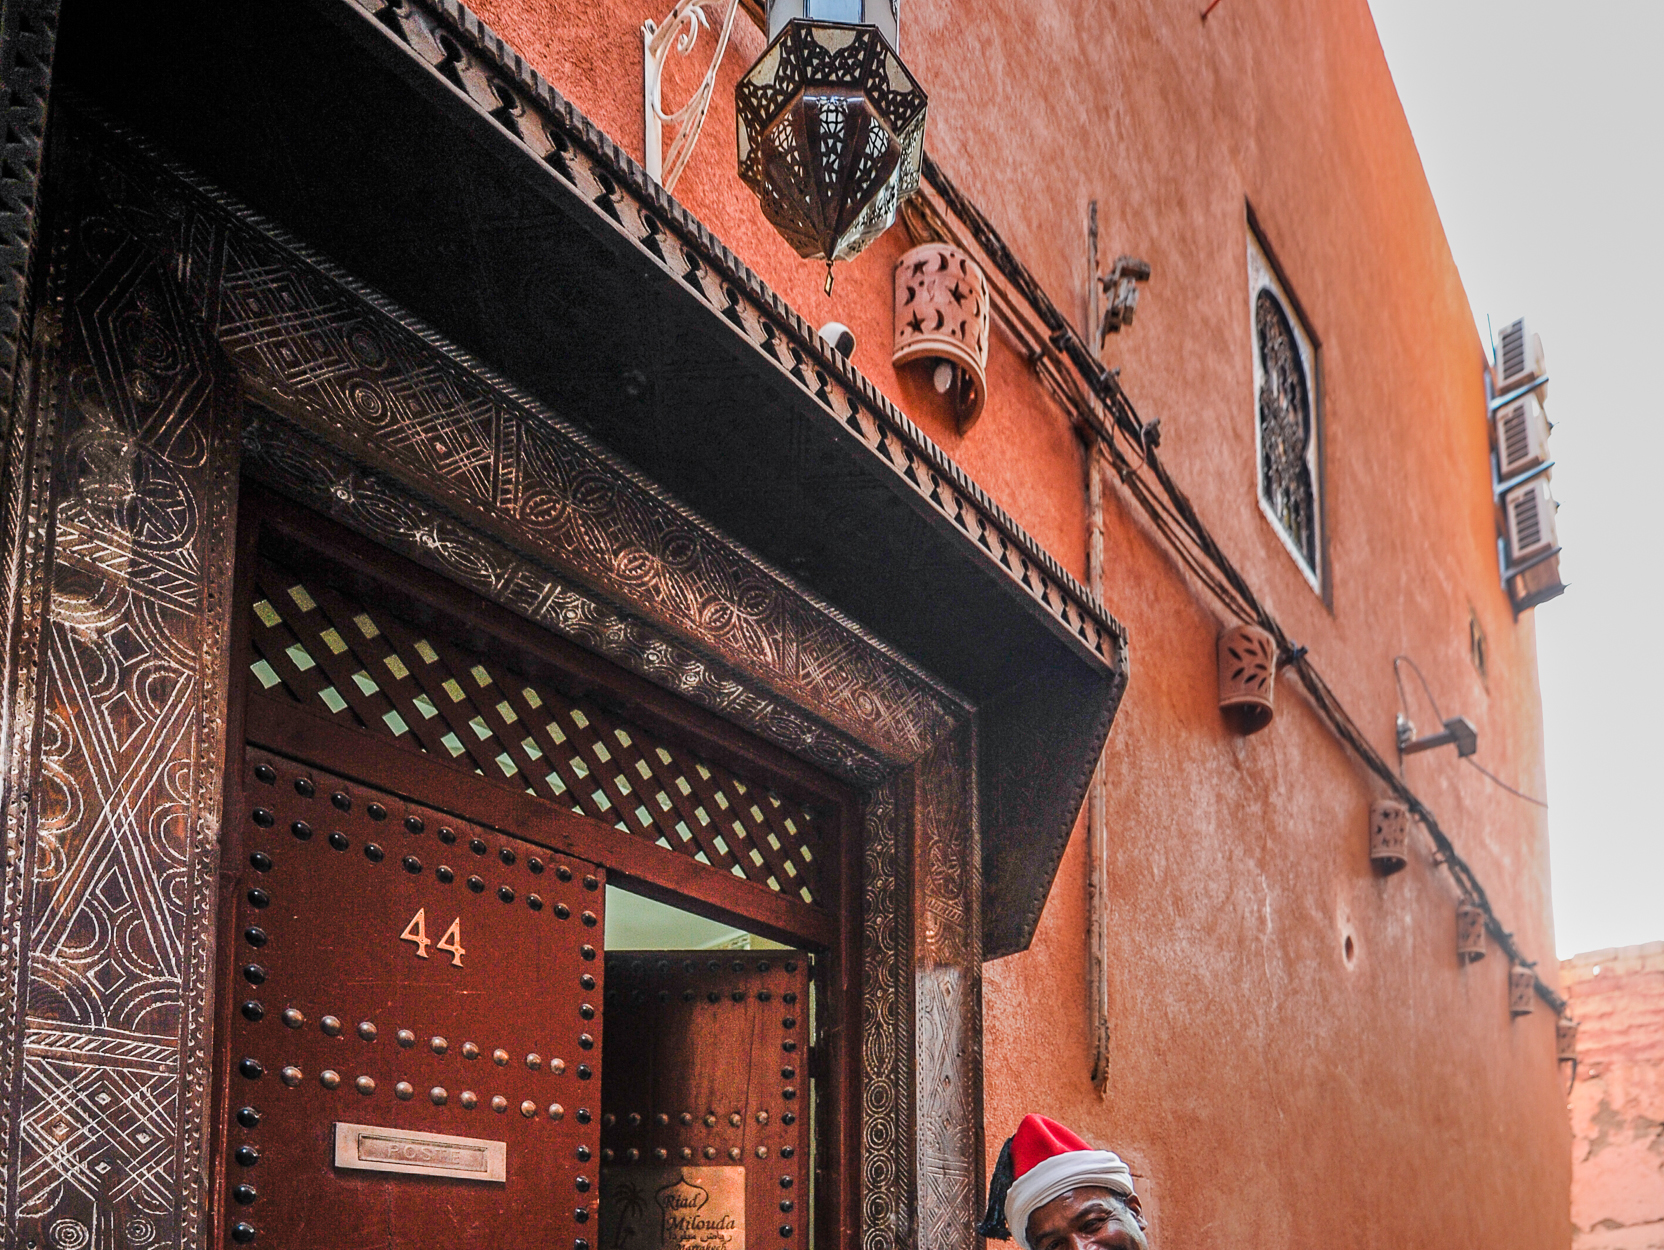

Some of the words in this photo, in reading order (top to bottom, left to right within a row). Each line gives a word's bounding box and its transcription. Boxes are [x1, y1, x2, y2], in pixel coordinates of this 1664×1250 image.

[400, 907, 466, 967] 44
[388, 1144, 460, 1165] POSTE
[664, 1192, 702, 1210] Riad
[666, 1214, 736, 1231] Milouda
